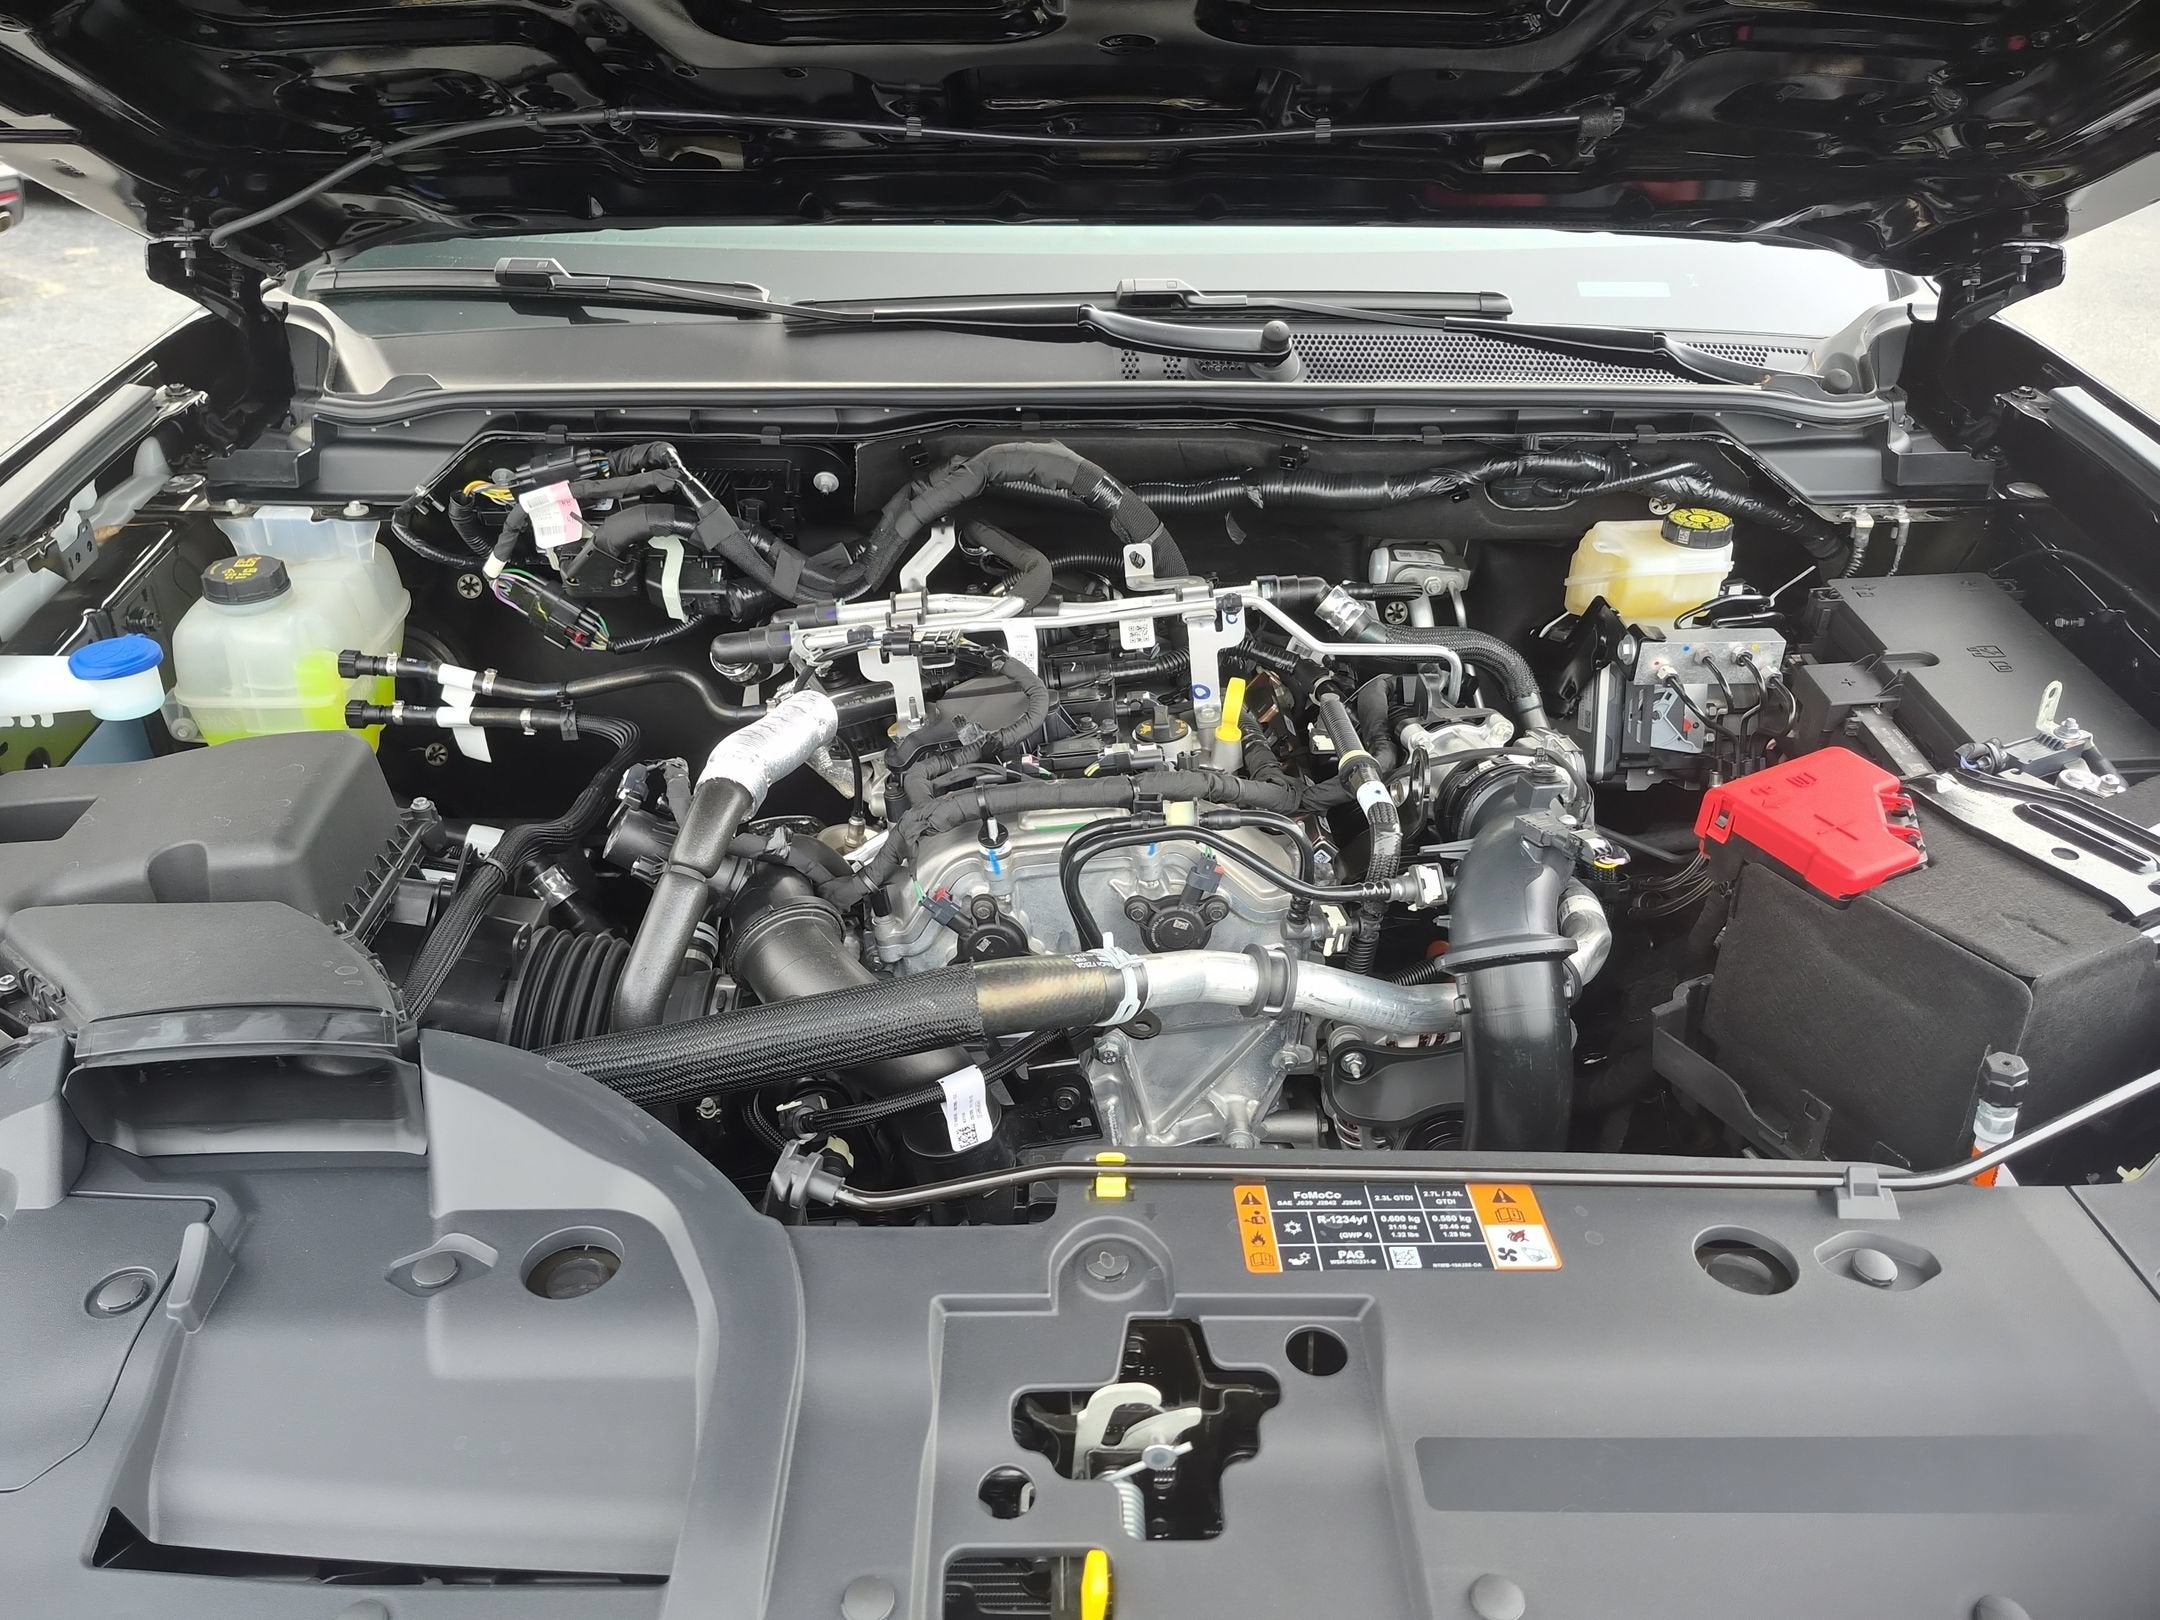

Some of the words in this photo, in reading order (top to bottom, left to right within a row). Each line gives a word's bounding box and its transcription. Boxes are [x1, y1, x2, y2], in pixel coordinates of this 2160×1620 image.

[1293, 1191, 1342, 1200] FoMoCo
[1316, 1215, 1368, 1225] R-1234yf
[1408, 1214, 1421, 1224] kg
[1459, 1214, 1472, 1224] kg
[1337, 1250, 1366, 1259] PAG
